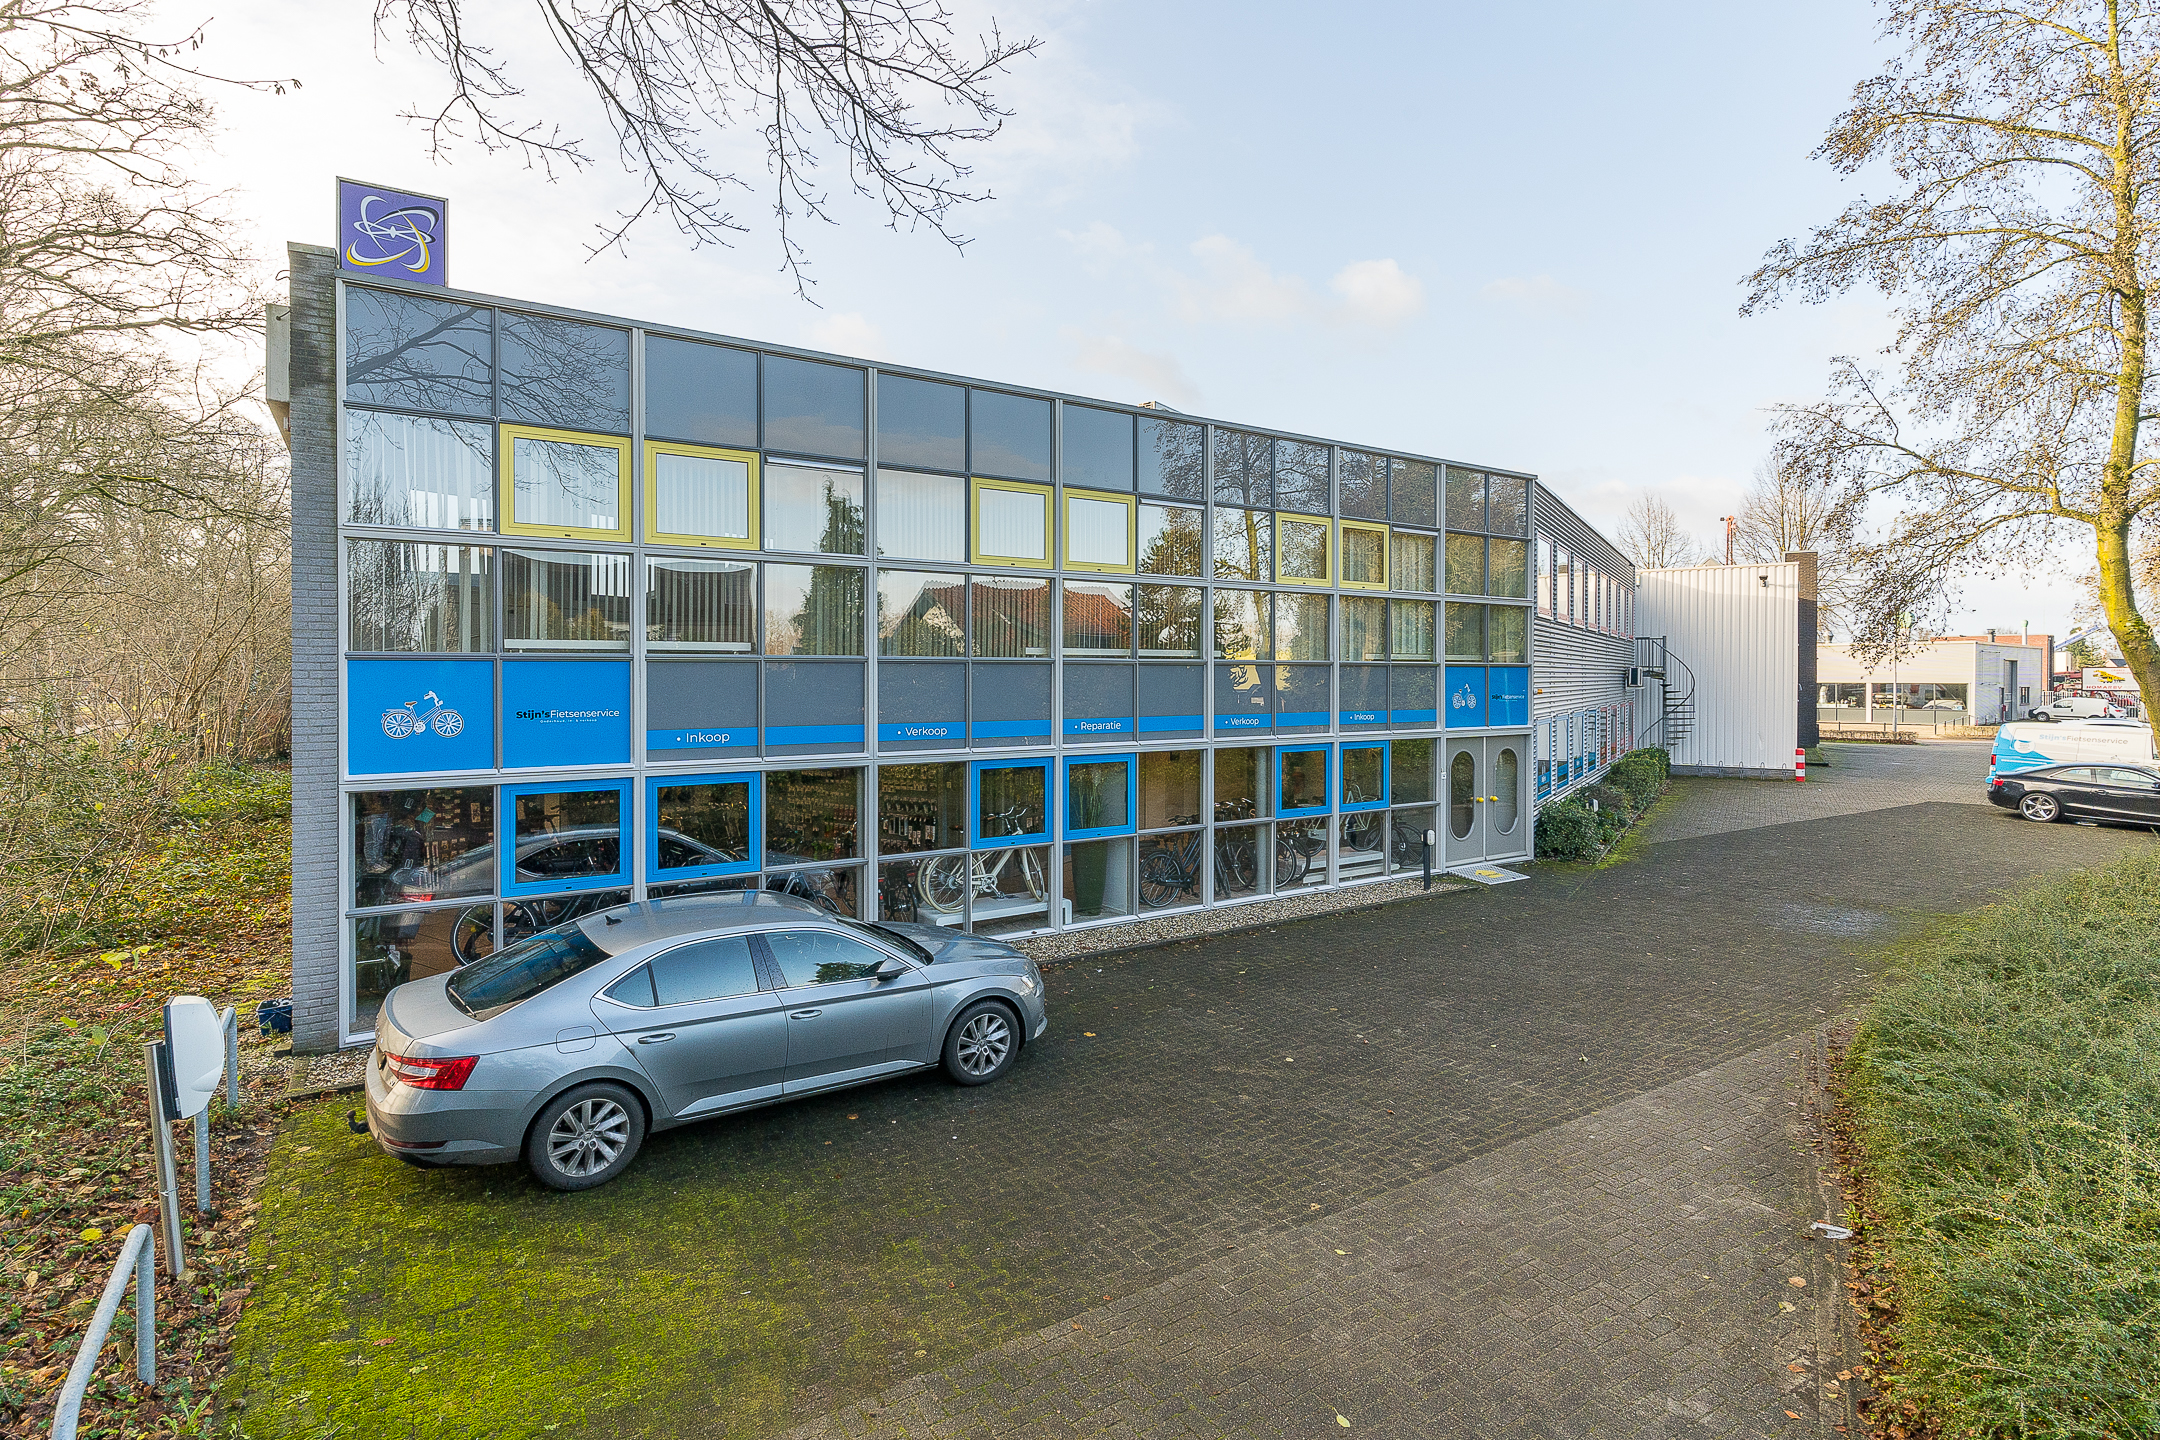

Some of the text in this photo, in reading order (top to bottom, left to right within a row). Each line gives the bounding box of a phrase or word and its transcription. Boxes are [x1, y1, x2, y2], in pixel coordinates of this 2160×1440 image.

[1230, 717, 1260, 727] Verkoop
[1354, 713, 1375, 722] Inkoop
[905, 726, 948, 738] Verkoop
[1080, 720, 1122, 732] Reparatie
[686, 732, 730, 744] Inkoop
